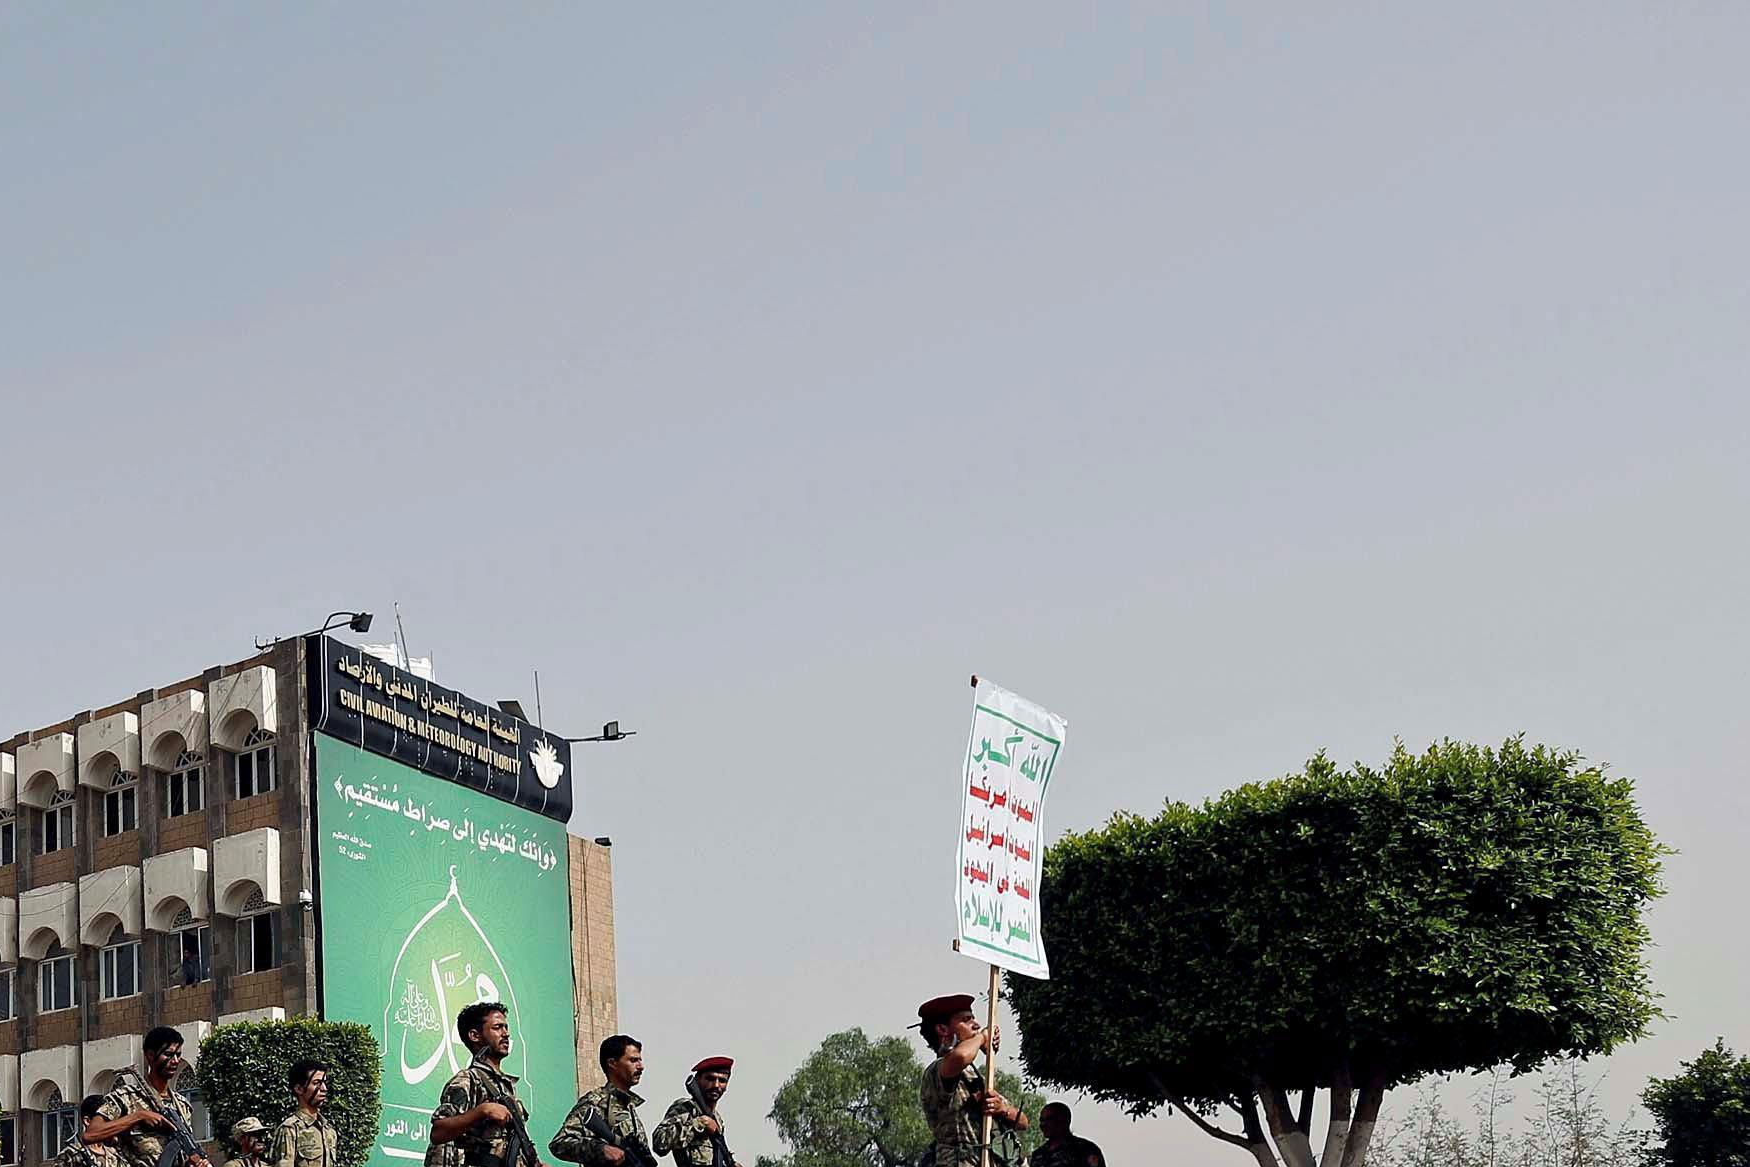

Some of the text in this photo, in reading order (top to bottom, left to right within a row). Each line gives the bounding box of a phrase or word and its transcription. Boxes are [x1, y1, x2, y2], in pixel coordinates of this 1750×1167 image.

[340, 689, 521, 775] CIVIL AVIATION & METEOROLOGY AUTHORITY
[972, 730, 1049, 784] الله أكبر
[964, 856, 994, 889] اليهود
[1005, 908, 1033, 946] النصر
[384, 1120, 408, 1137] النور
